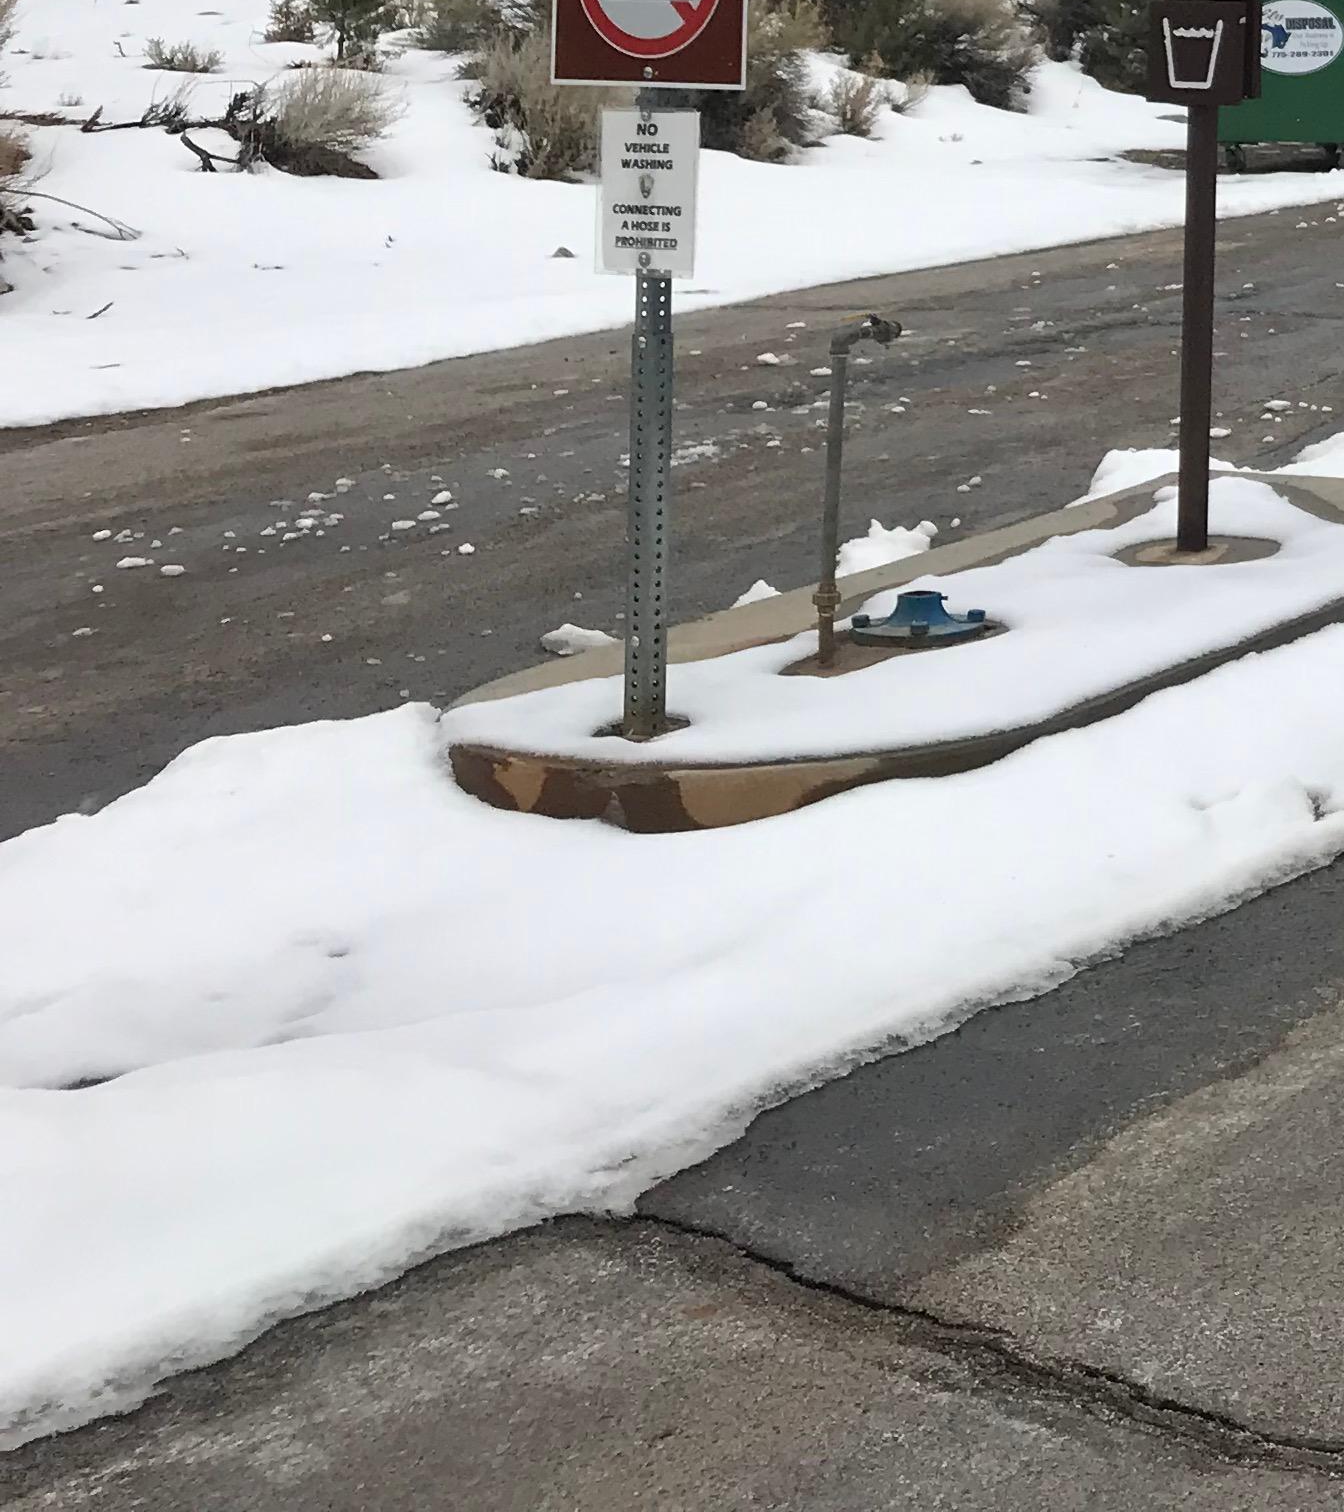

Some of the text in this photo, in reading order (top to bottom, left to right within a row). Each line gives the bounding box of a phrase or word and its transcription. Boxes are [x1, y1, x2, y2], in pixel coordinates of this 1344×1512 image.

[1285, 17, 1336, 30] DISPOSAL
[636, 123, 658, 136] NO
[624, 142, 670, 154] VEHICLE
[621, 159, 673, 170] WASHING
[612, 203, 682, 217] CONNECTING
[621, 220, 671, 232] A HOSE IS
[615, 236, 678, 249] PROHIBITED
